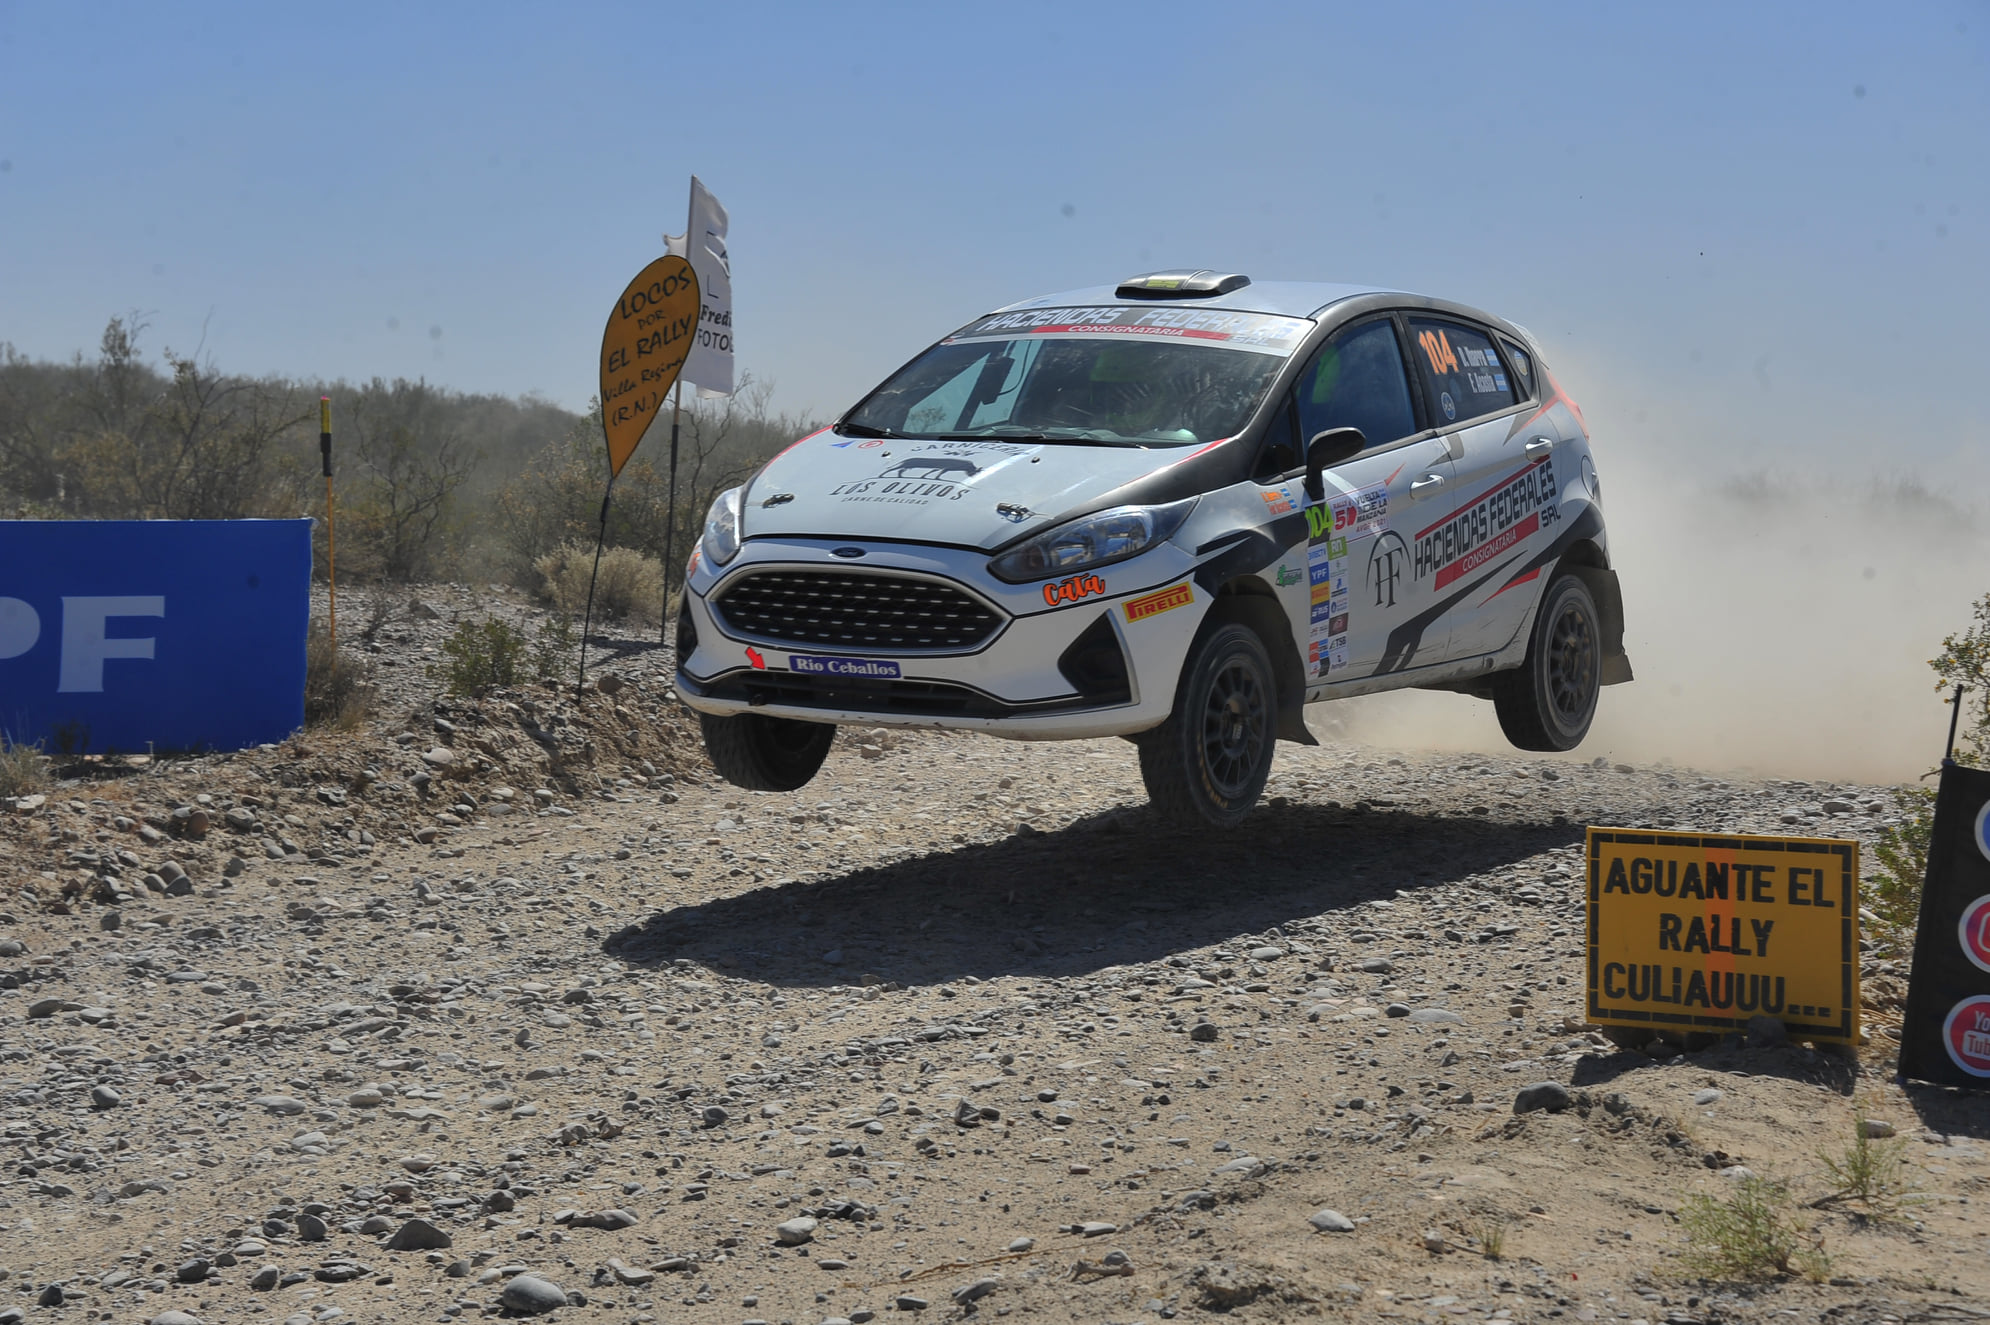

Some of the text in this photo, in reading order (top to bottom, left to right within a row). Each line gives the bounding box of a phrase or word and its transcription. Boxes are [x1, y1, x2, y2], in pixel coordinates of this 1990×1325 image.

[620, 266, 691, 320] LOCOS
[976, 308, 1129, 331] HACIENDAS
[1067, 325, 1184, 337] CONSIGNATARIA
[608, 313, 692, 373] EL RALLY
[1418, 329, 1459, 375] 104
[603, 378, 637, 403] Villa
[829, 481, 971, 501] LOS OLIVOS
[1305, 503, 1334, 539] 104
[1414, 459, 1556, 582] HACIENDAS FEDERALES
[1541, 503, 1561, 528] SRL
[1462, 527, 1517, 572] CONSIGNATARIA
[1043, 573, 1105, 606] Cata
[1311, 567, 1327, 580] YPF
[1126, 585, 1190, 620] PIRELLI
[796, 658, 897, 676] Rio Ceballos
[1603, 856, 1835, 908] AGUANTE EL
[1658, 912, 1775, 957] RALLY
